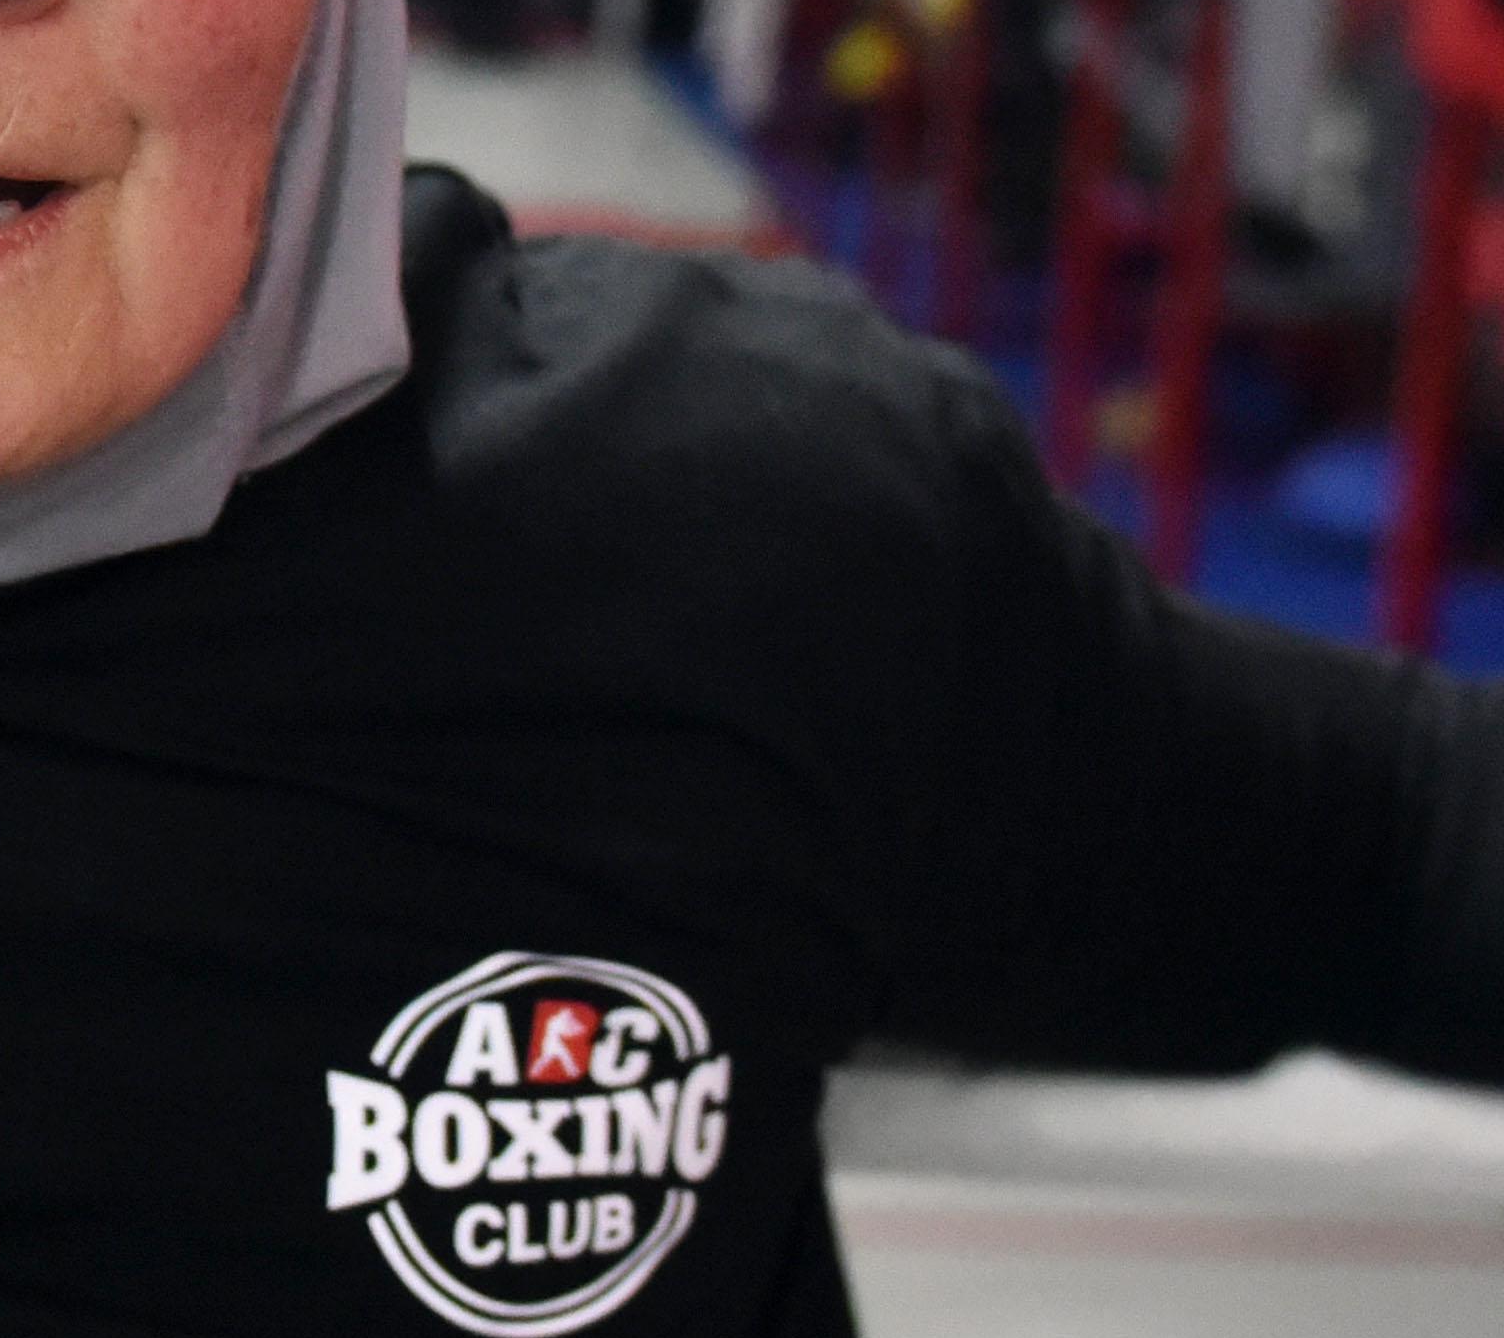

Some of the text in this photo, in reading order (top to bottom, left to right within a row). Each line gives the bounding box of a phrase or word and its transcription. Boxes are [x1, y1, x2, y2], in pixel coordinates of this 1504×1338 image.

[445, 999, 661, 1088] ARC
[325, 1054, 732, 1211] BOXING
[453, 1193, 635, 1267] CLUB
